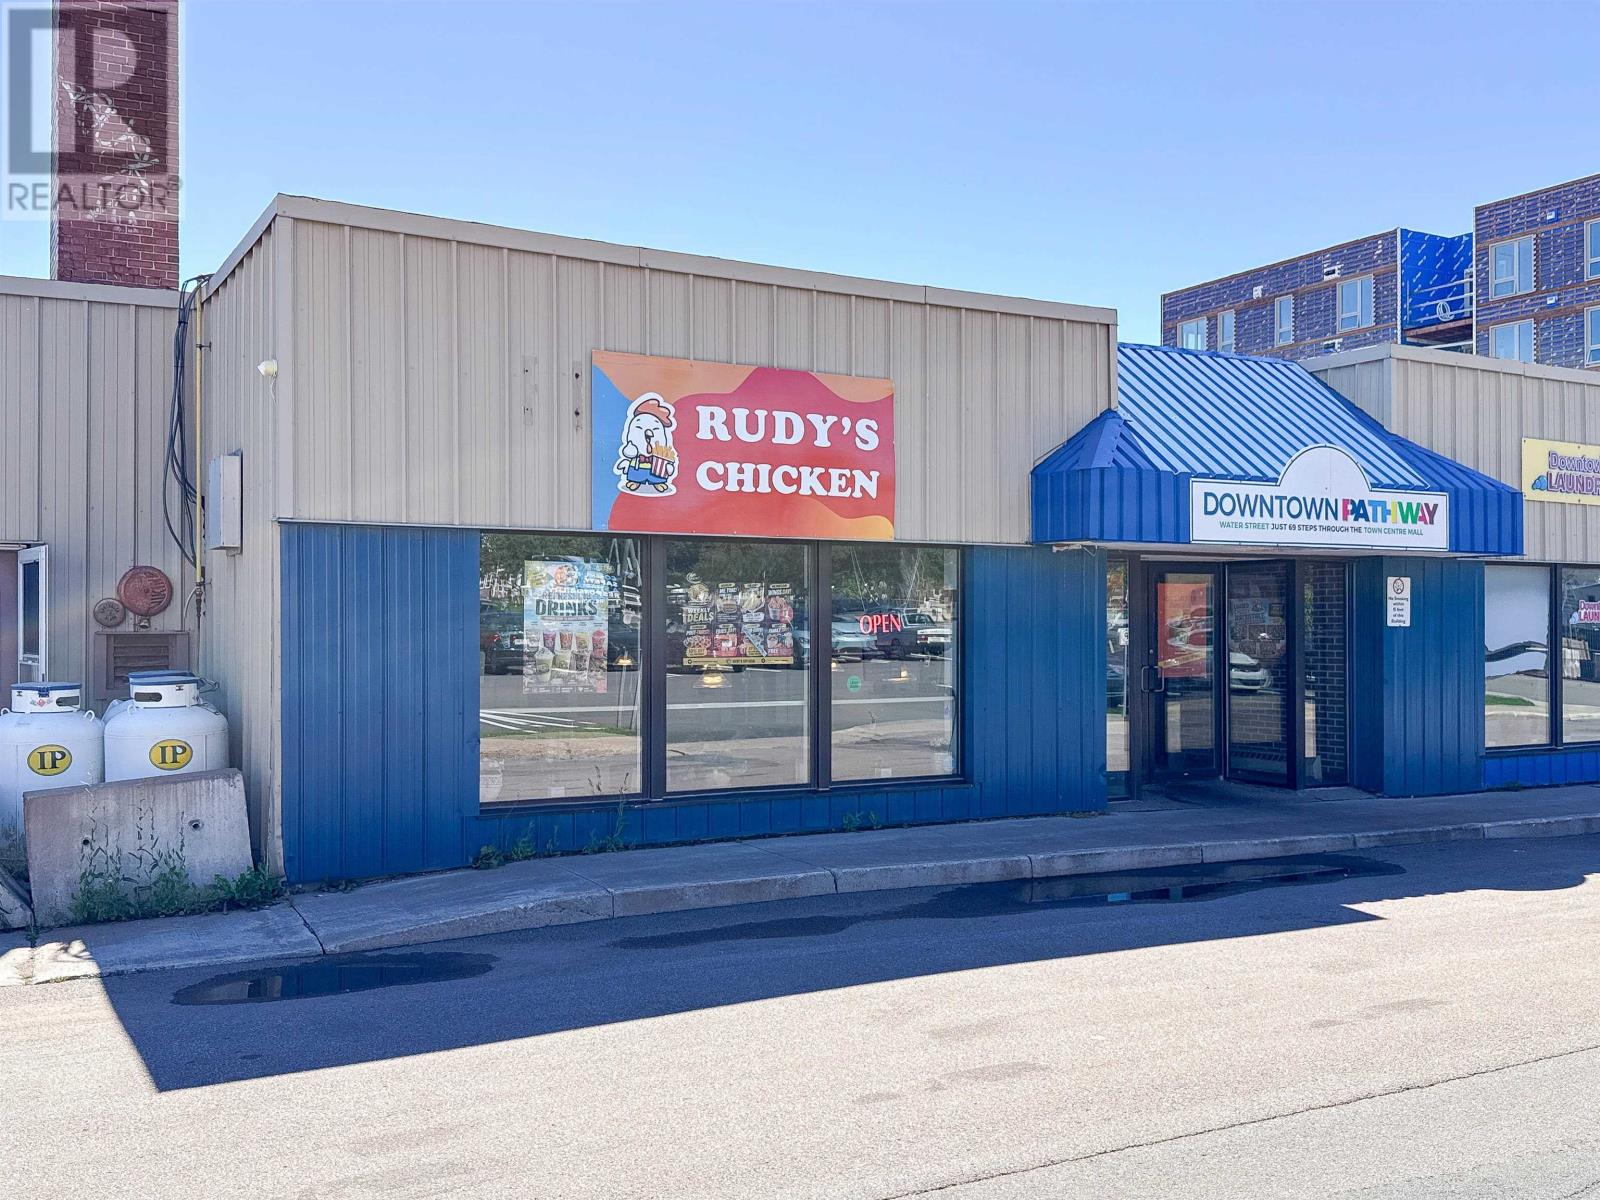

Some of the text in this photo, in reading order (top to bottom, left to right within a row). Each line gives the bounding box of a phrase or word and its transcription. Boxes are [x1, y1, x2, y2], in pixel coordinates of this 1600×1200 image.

[695, 405, 880, 451] RUDY'S
[695, 461, 881, 500] CHICKEN
[1203, 491, 1439, 526] DOWNTOWN PATHWAY
[1219, 521, 1243, 529] WATER
[1244, 522, 1270, 530] STREET
[1297, 524, 1318, 532] STEPS
[1319, 525, 1349, 533] THROUGH
[1383, 527, 1407, 535] CENTRE
[1407, 528, 1424, 536] MALL
[535, 599, 598, 616] DRINKS
[687, 612, 714, 622] DEALS
[859, 613, 902, 635] OPEN
[36, 750, 67, 770] IP
[158, 745, 187, 765] IP
